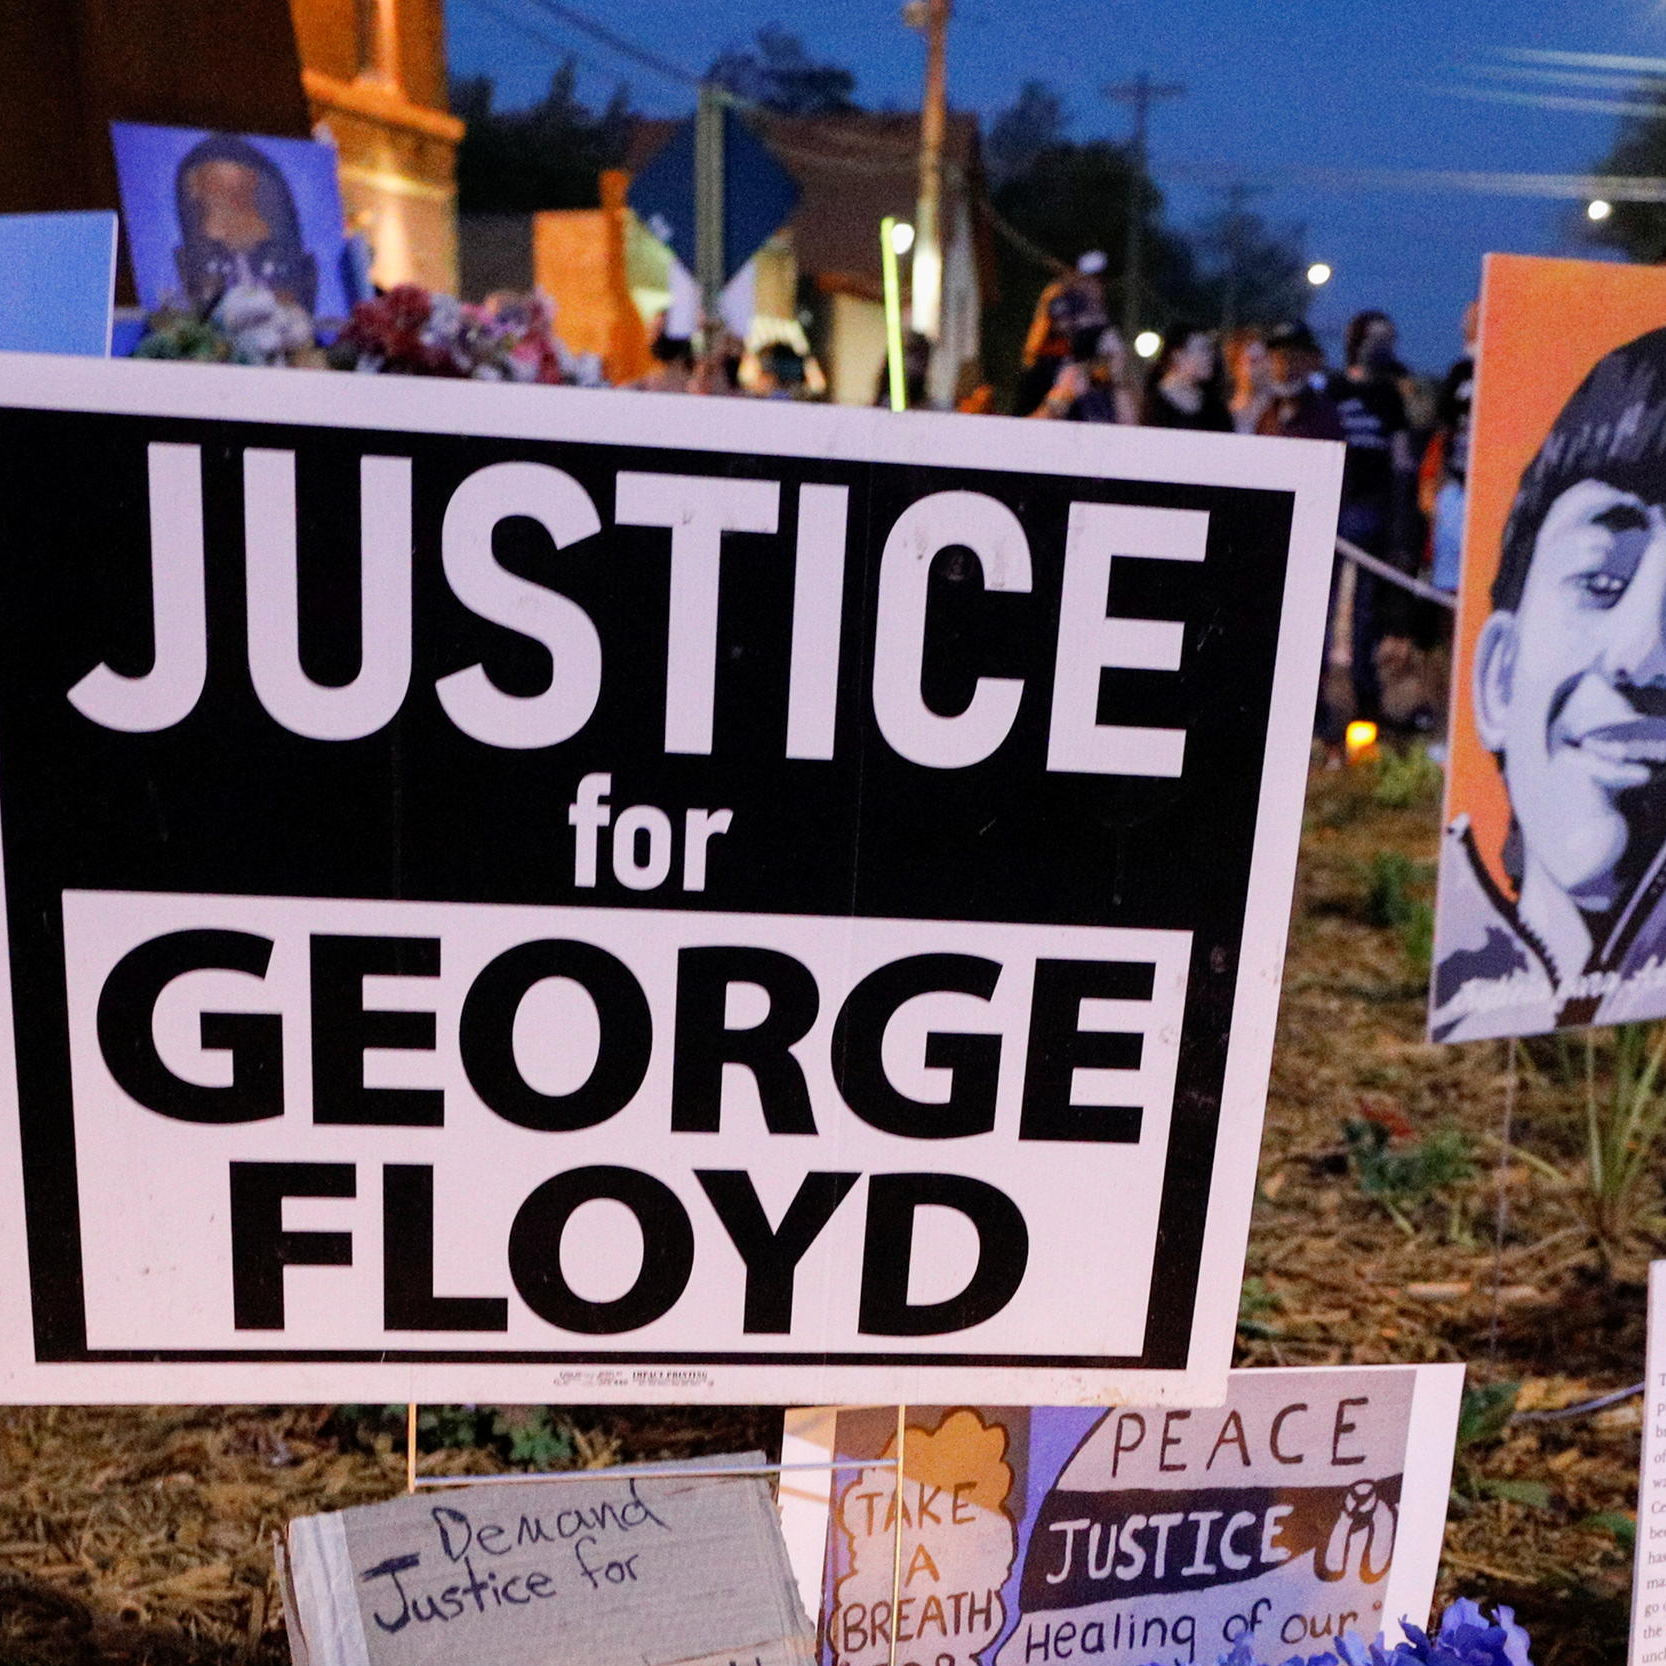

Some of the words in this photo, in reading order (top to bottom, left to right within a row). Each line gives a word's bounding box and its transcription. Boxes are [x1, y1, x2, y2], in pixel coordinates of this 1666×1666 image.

[66, 442, 1210, 778] JUSTICE
[568, 772, 734, 892] for
[96, 928, 1156, 1144] GEORGE
[229, 1161, 1030, 1337] FLOYD
[1110, 1397, 1369, 1478] PEACE
[433, 1478, 669, 1561] Demand
[855, 1481, 978, 1537] TAKE
[1045, 1504, 1294, 1584] JUSTICE
[362, 1553, 556, 1633] Justice
[576, 1536, 642, 1589] for
[905, 1543, 940, 1585] A
[1649, 1551, 1666, 1564] has
[843, 1590, 994, 1653] BREATH
[1025, 1612, 1197, 1666] Healing
[1222, 1597, 1271, 1642] of
[1644, 1625, 1662, 1639] the
[1645, 1604, 1659, 1618] go
